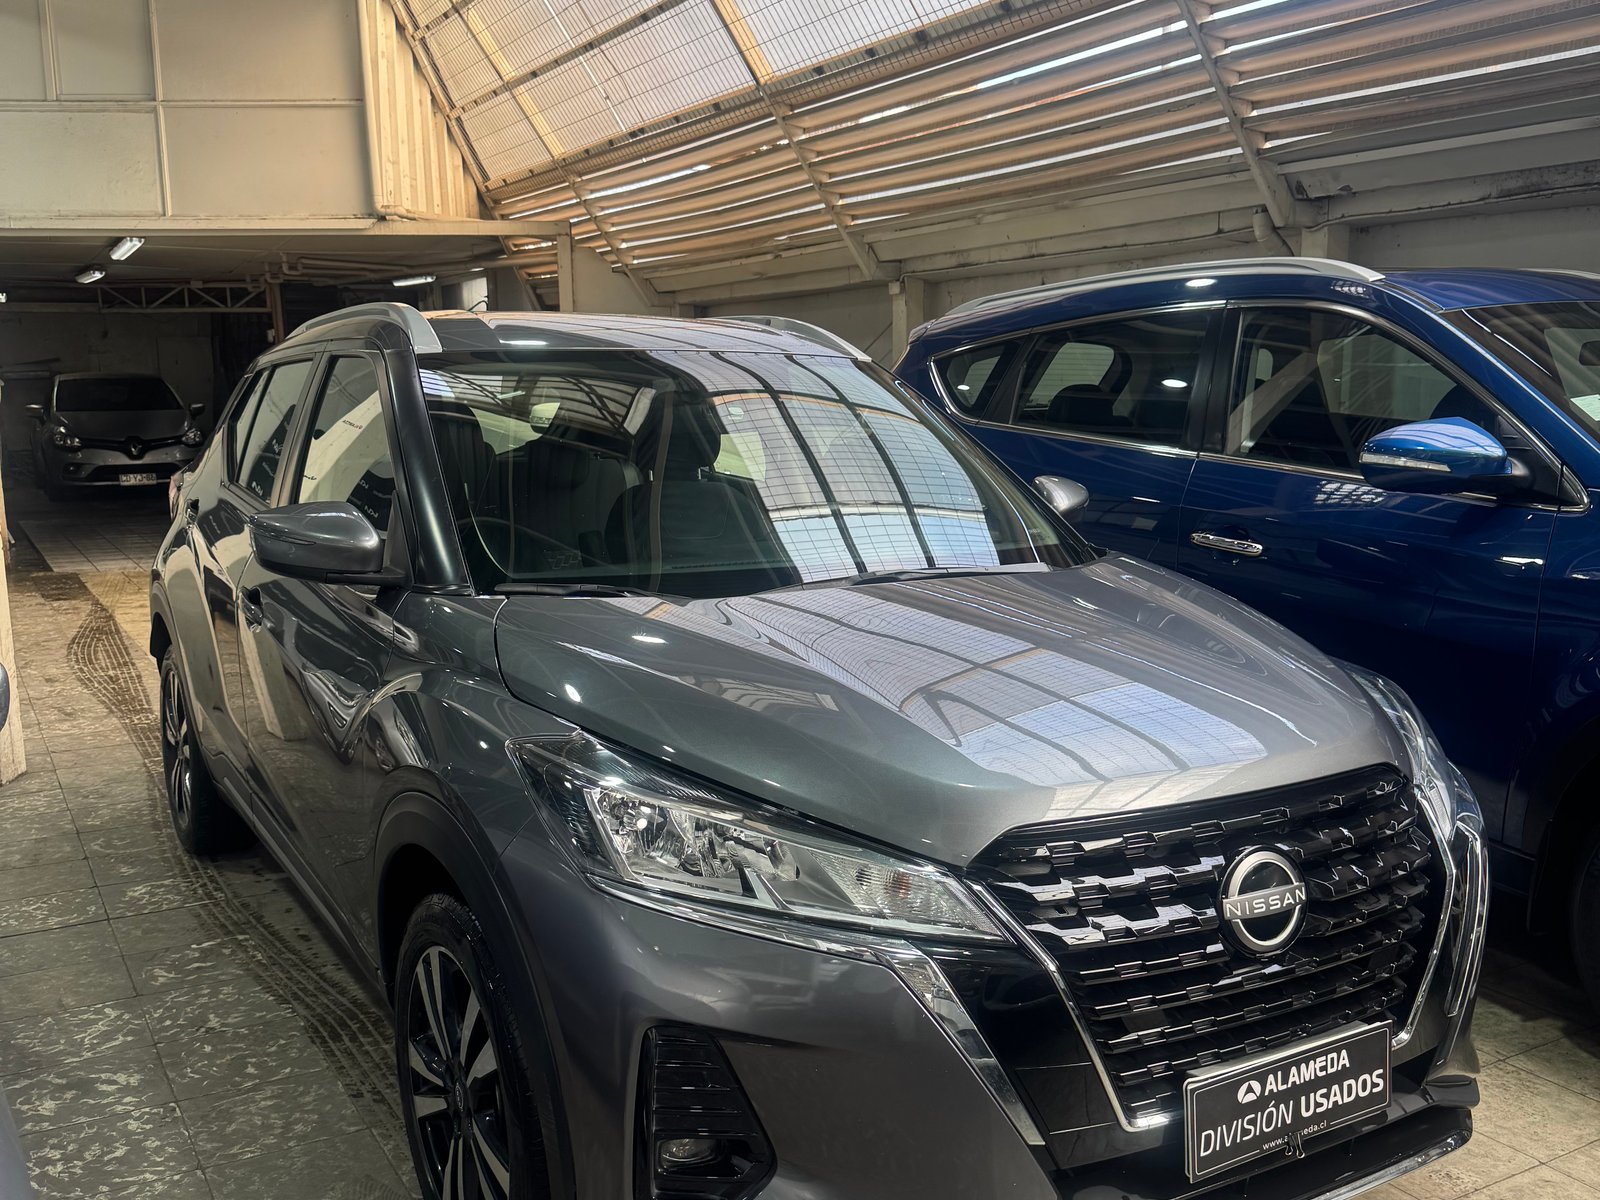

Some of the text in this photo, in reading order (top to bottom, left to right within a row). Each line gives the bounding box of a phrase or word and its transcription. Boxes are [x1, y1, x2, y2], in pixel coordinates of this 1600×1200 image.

[1226, 886, 1306, 917] NISSAN
[1264, 1049, 1350, 1096] ALAMEDA
[1200, 1069, 1384, 1157] DIVISIÓN USADOS
[1262, 1119, 1327, 1150] www.aeda.cl
